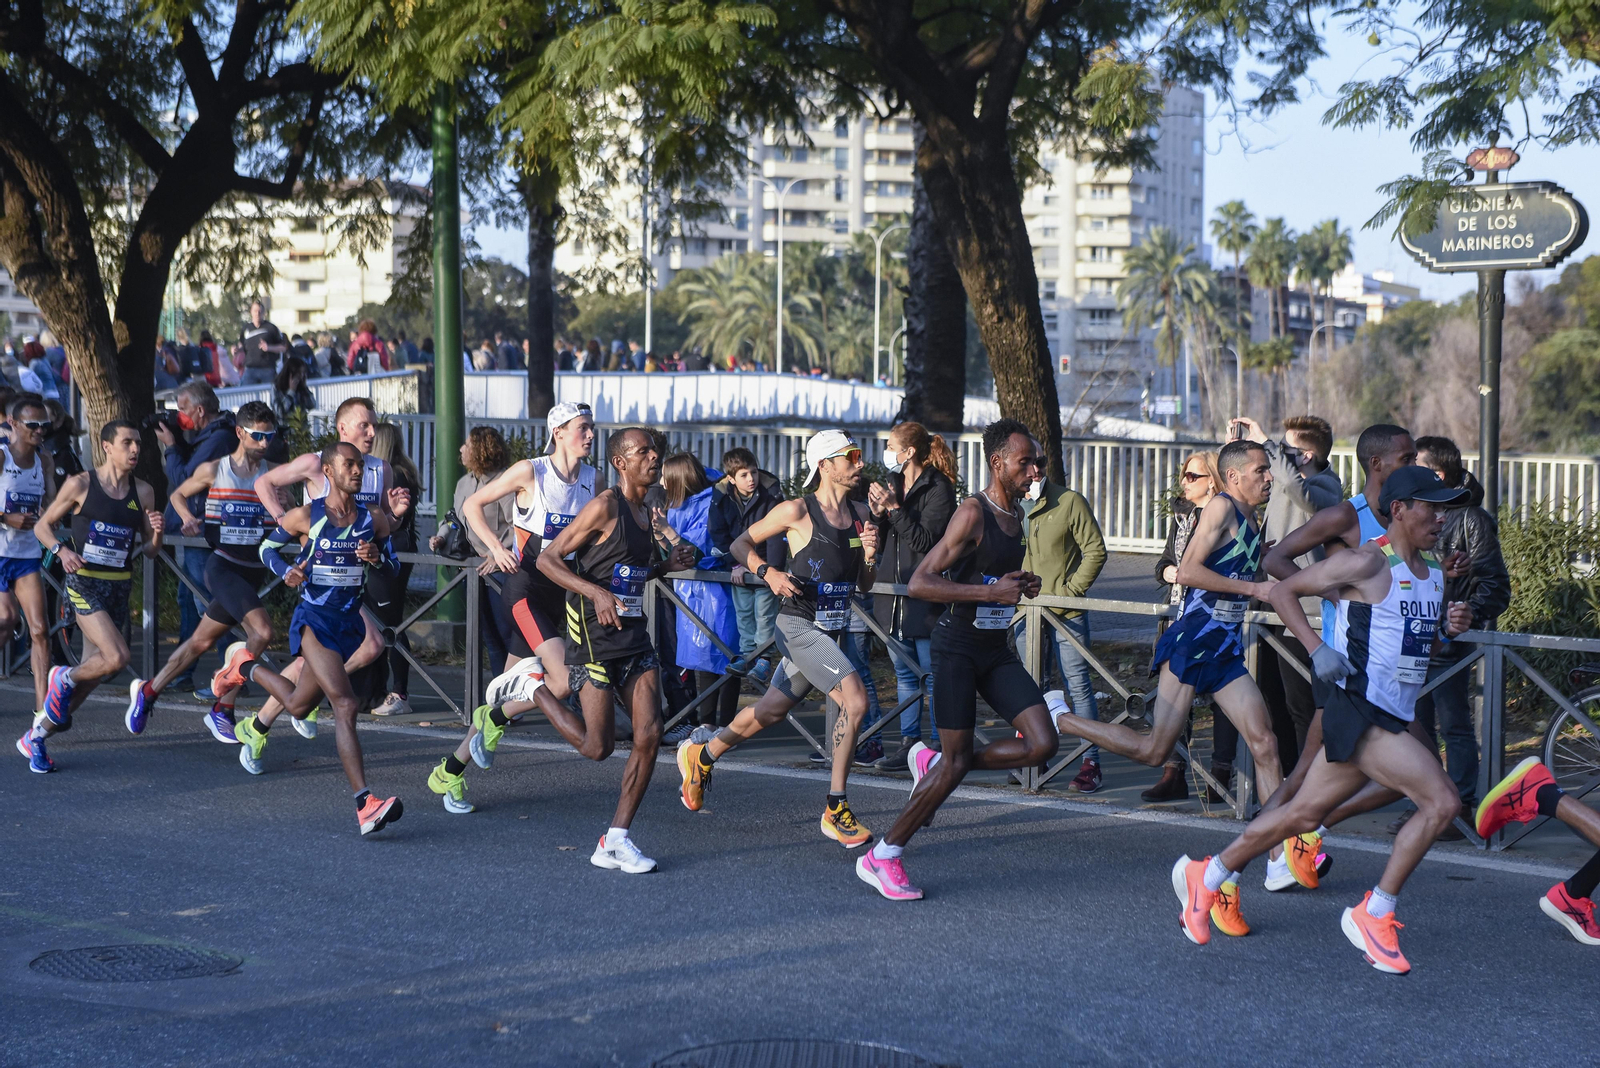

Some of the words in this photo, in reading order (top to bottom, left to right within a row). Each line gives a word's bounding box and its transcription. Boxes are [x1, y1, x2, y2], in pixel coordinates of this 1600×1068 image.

[1458, 217, 1477, 231] DE
[1487, 213, 1517, 230] LOS
[1442, 233, 1534, 252] MARINEROS
[240, 518, 245, 526] 3
[105, 525, 130, 535] ZURICH
[106, 539, 115, 547] 30
[332, 541, 359, 549] ZURICH
[335, 556, 345, 564] 22
[834, 600, 843, 609] 63
